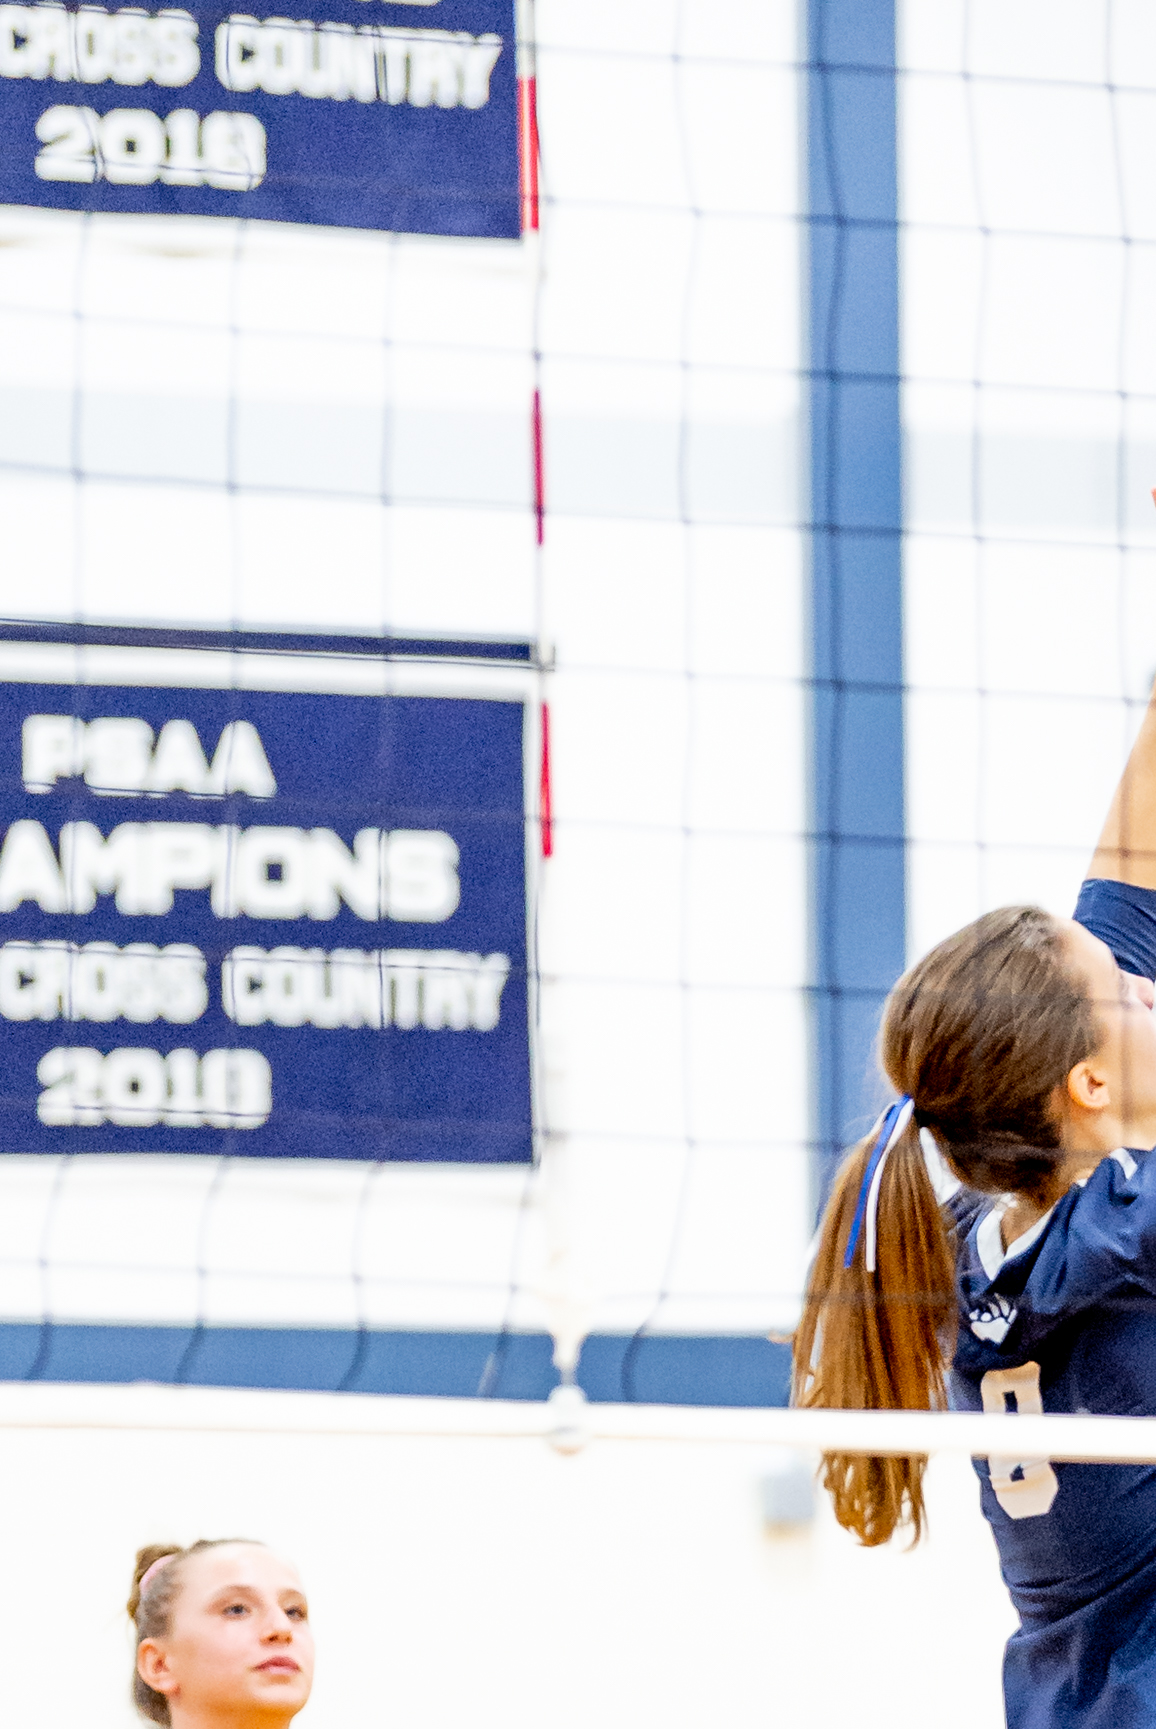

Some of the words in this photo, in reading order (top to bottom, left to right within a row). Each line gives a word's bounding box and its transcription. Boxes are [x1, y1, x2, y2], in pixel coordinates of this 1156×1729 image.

[0, 3, 200, 87] CROSS
[215, 14, 502, 109] COUNTRY
[0, 940, 207, 1023] CROSS
[222, 946, 509, 1032] COUNTRY
[980, 1361, 1058, 1520] 8
